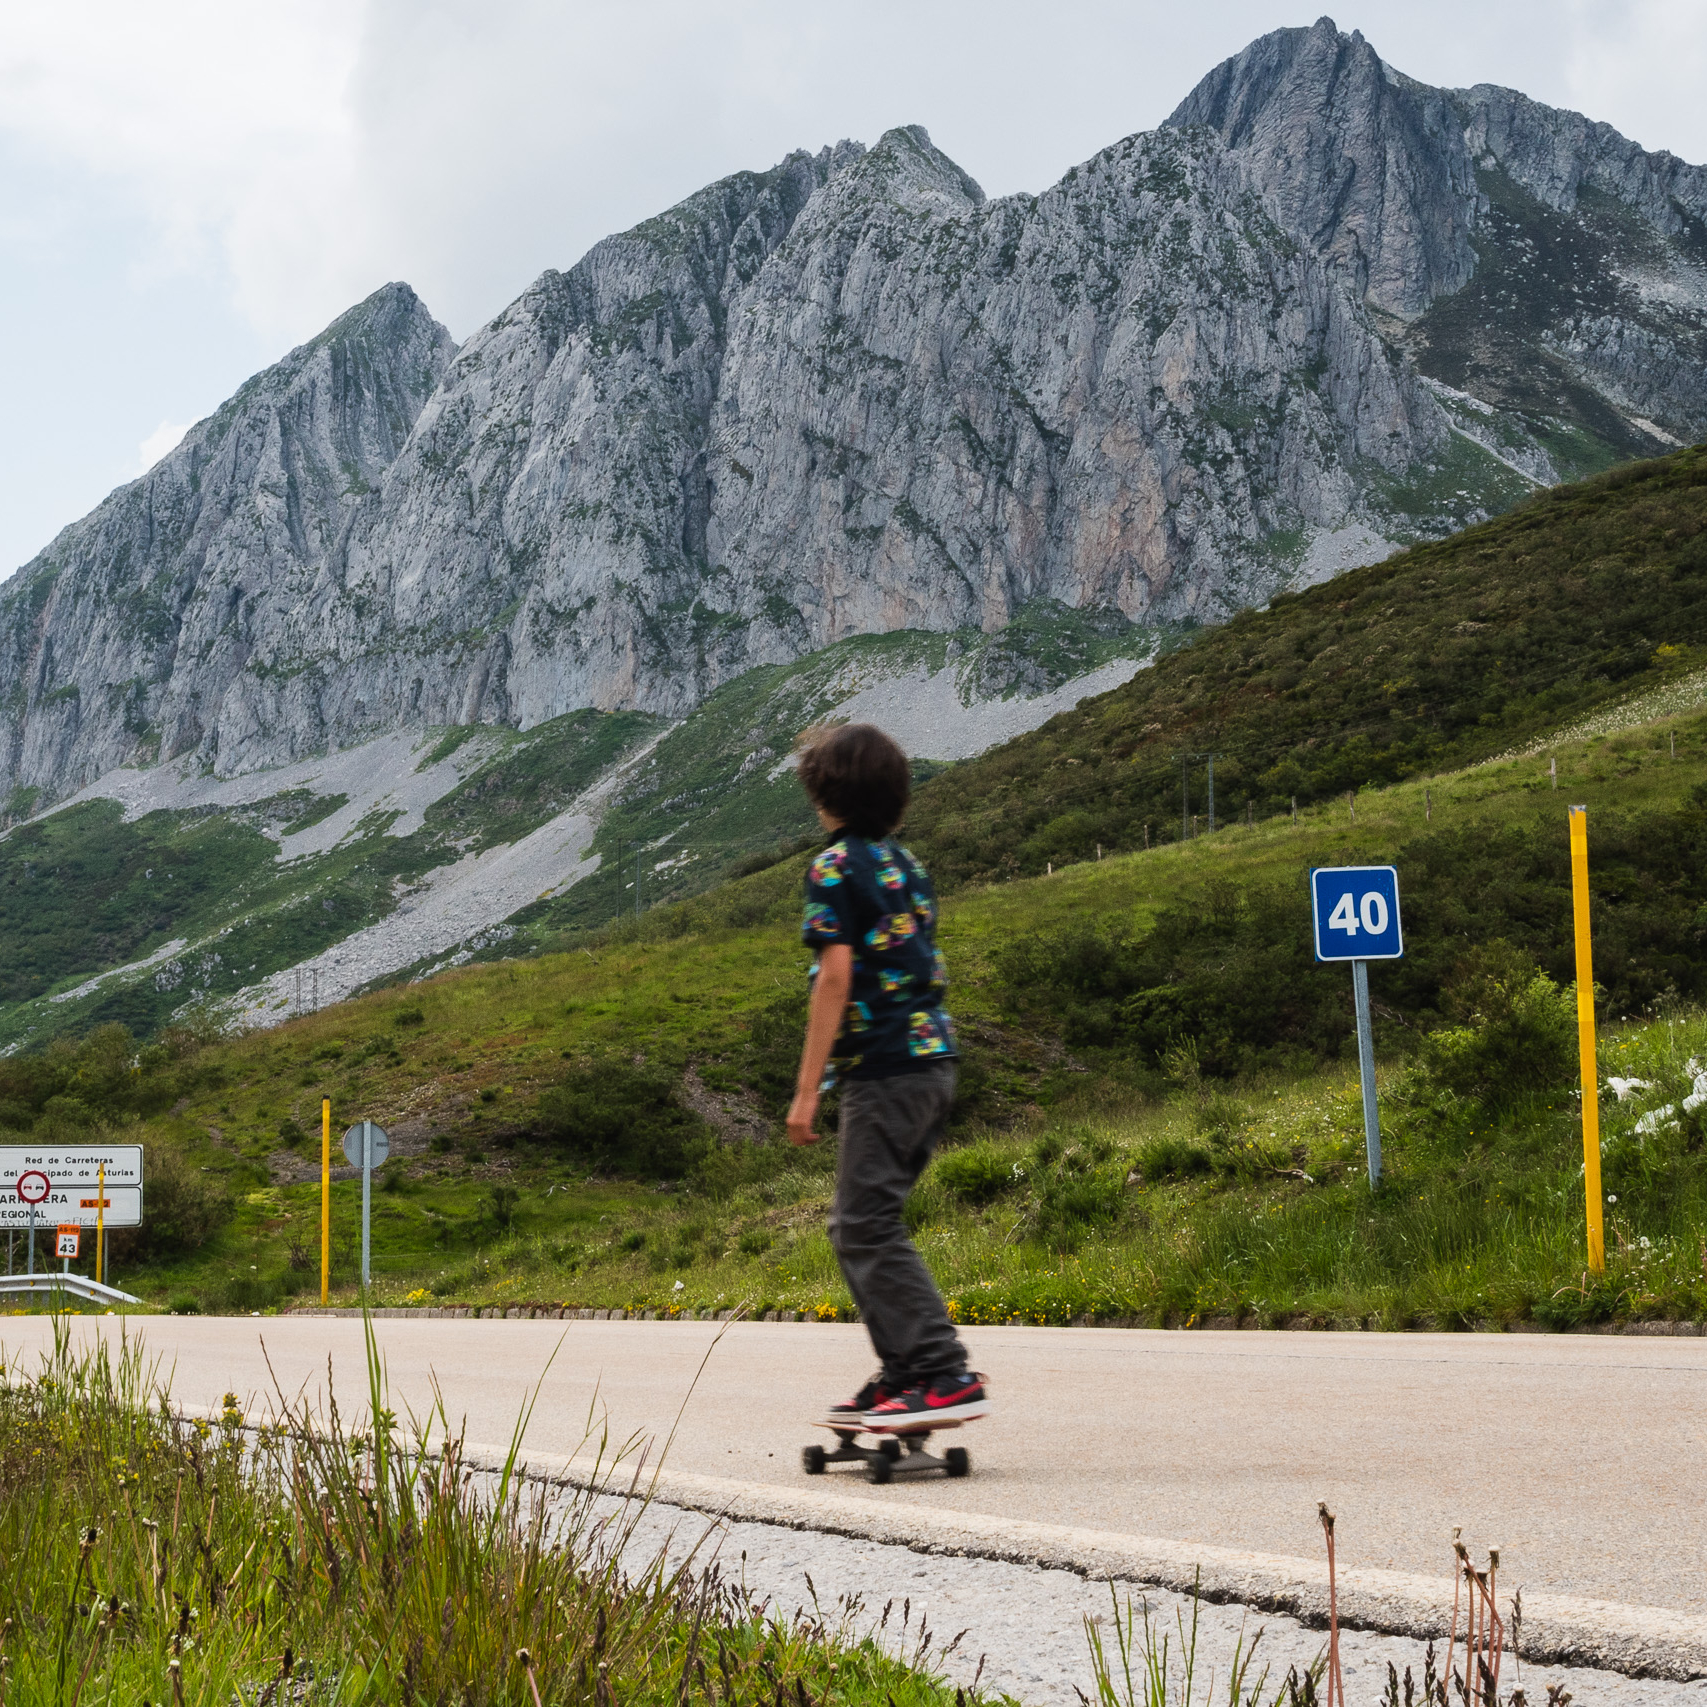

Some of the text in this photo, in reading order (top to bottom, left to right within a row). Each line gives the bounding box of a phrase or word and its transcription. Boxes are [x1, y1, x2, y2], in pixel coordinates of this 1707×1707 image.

[1328, 891, 1389, 936] 40
[65, 1156, 114, 1164] Carreteras
[78, 1169, 90, 1177] de
[0, 1194, 68, 1204] ARRERA
[81, 1200, 109, 1208] AS-2
[0, 1210, 47, 1219] EGIONAL
[60, 1244, 76, 1253] 43
